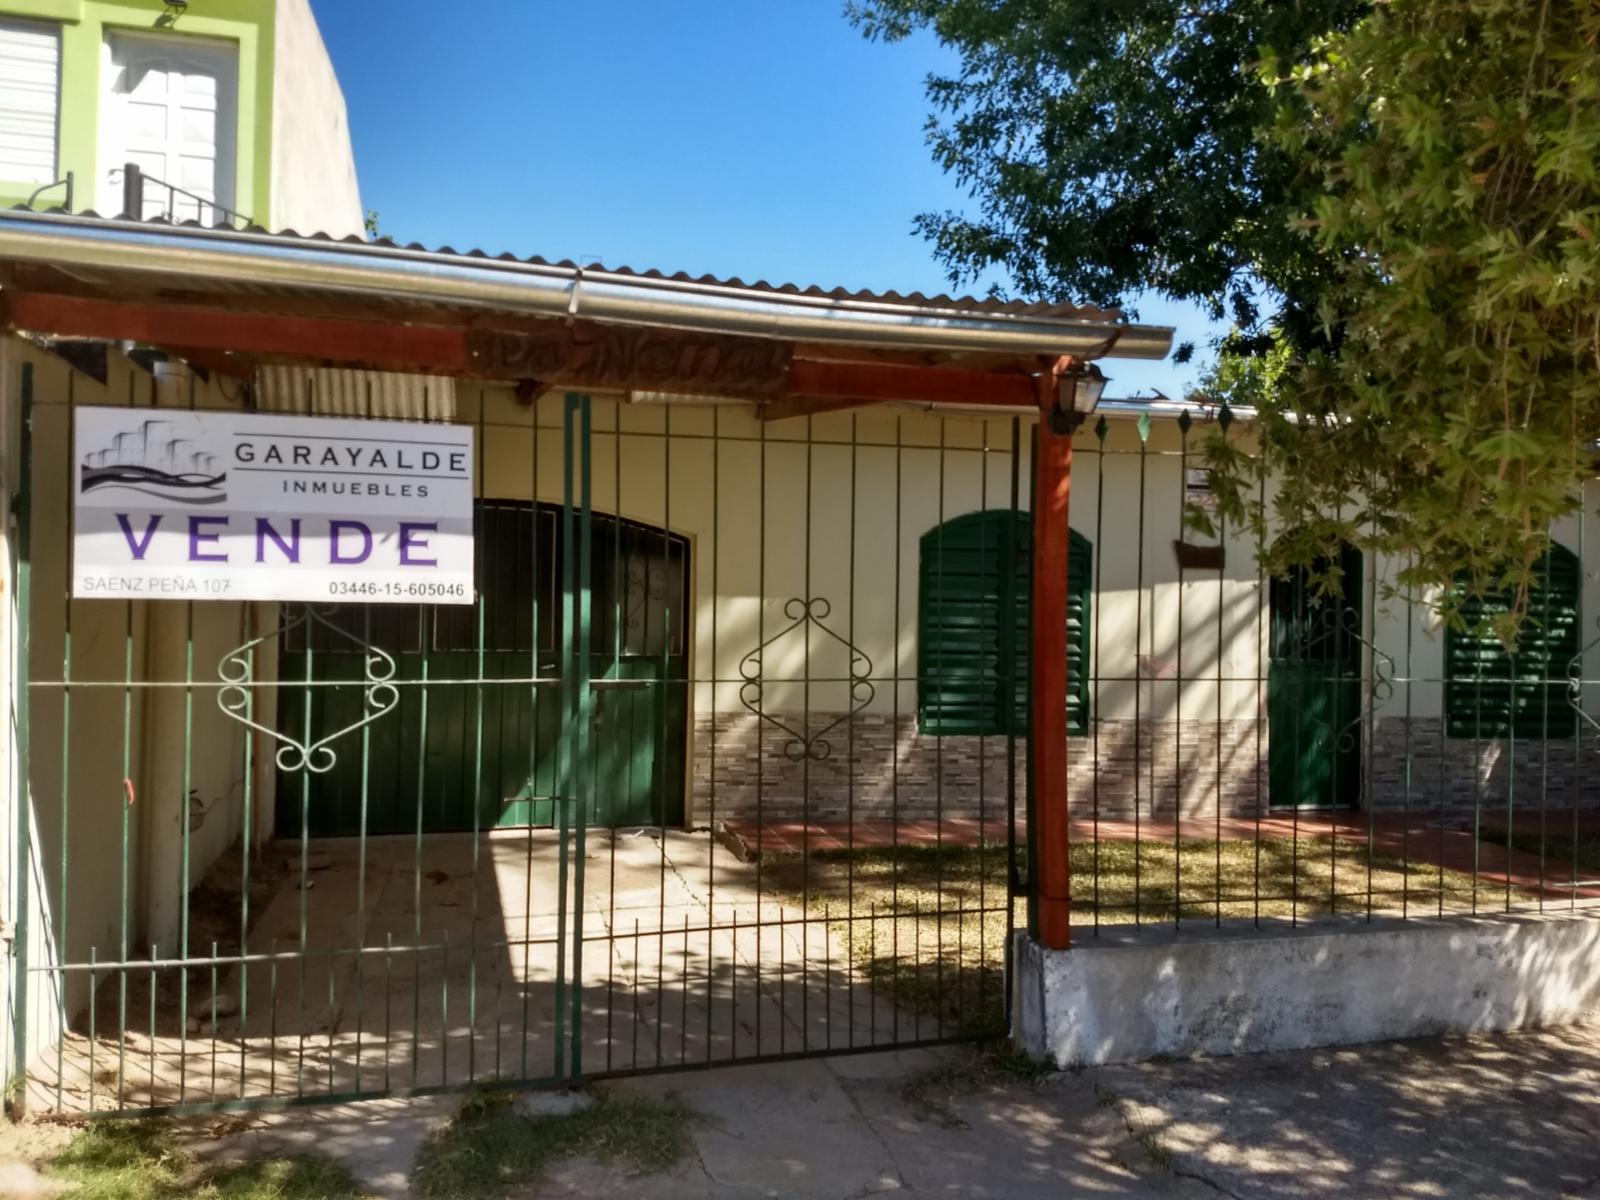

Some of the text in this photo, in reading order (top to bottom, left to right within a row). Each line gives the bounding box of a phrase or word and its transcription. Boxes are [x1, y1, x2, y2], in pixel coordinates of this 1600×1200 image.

[234, 442, 467, 472] GARAYALDE
[283, 480, 429, 497] INMUEBLES
[115, 513, 438, 567] VENDE
[83, 576, 232, 593] SAENZ PEÑA 107
[329, 581, 464, 596] 03446-15-605046
